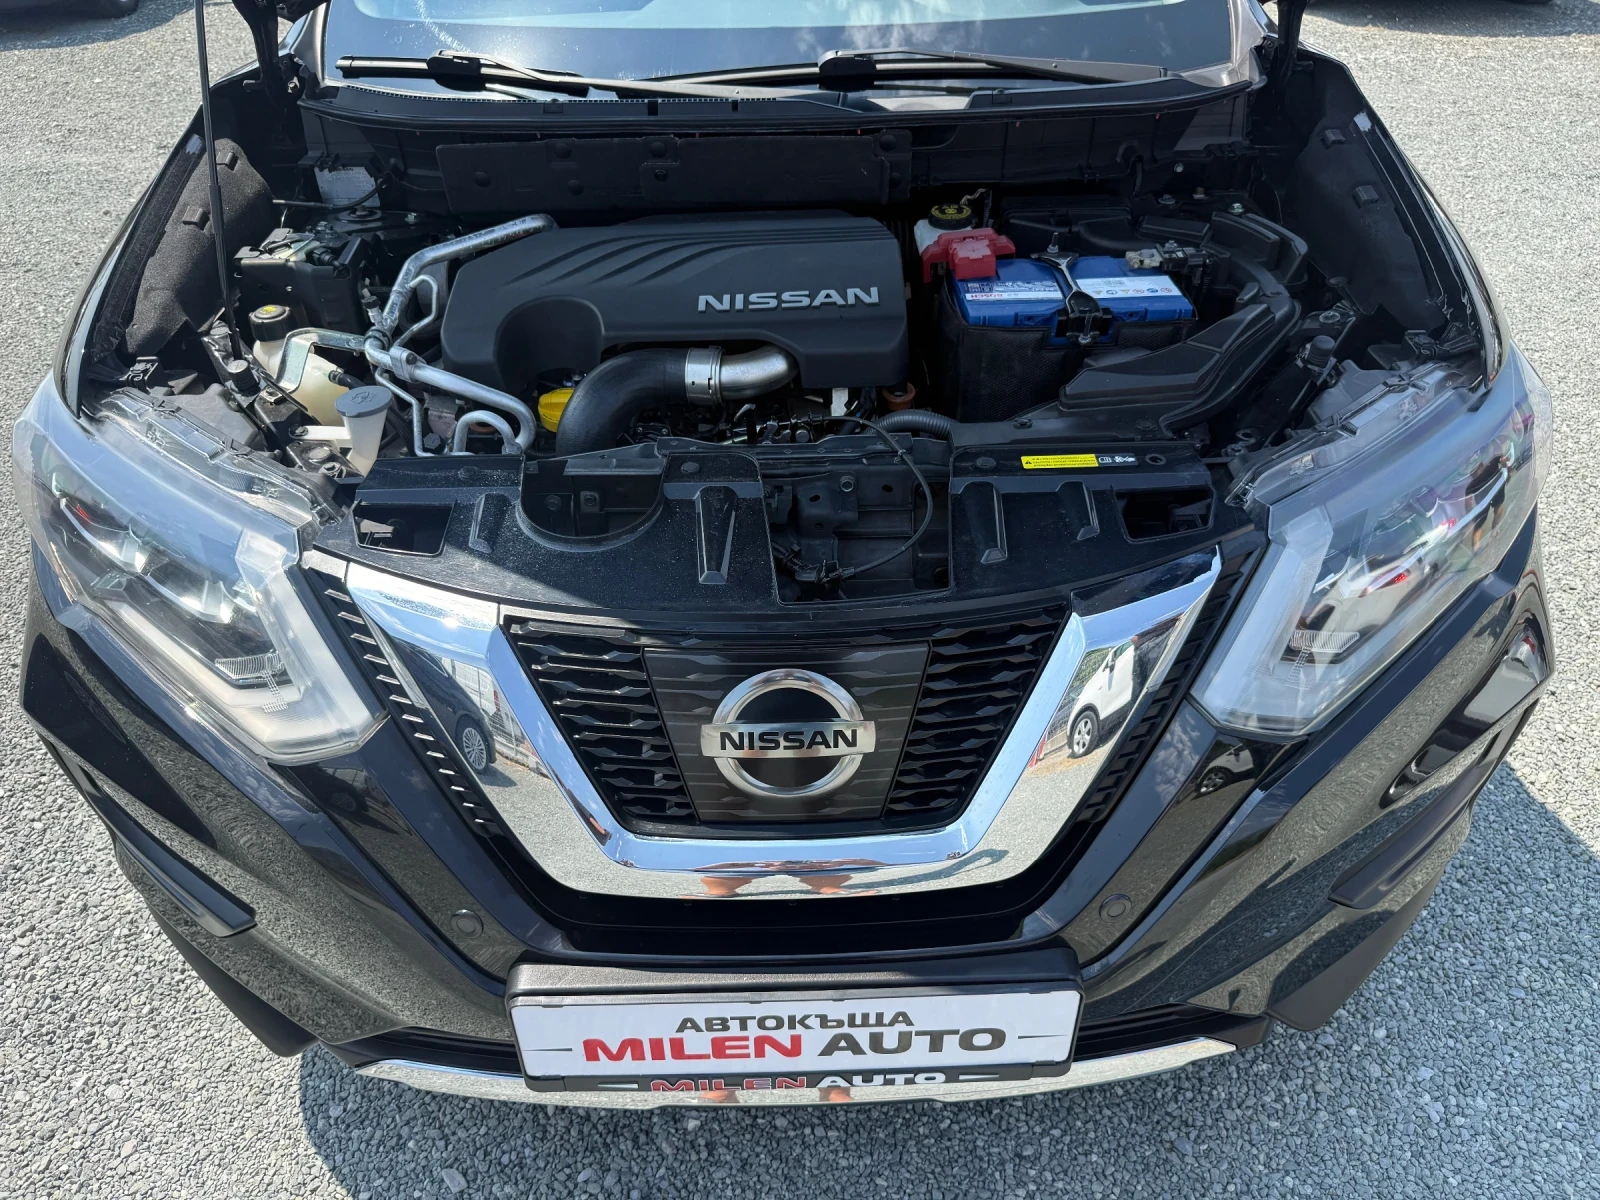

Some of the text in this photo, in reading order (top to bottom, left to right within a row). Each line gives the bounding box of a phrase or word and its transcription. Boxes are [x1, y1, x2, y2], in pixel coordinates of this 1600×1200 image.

[697, 286, 880, 312] NISSAN
[719, 728, 858, 751] NISSAN
[582, 1027, 1007, 1062] MILEN AUTO
[650, 1072, 946, 1092] MILEN AUTO
